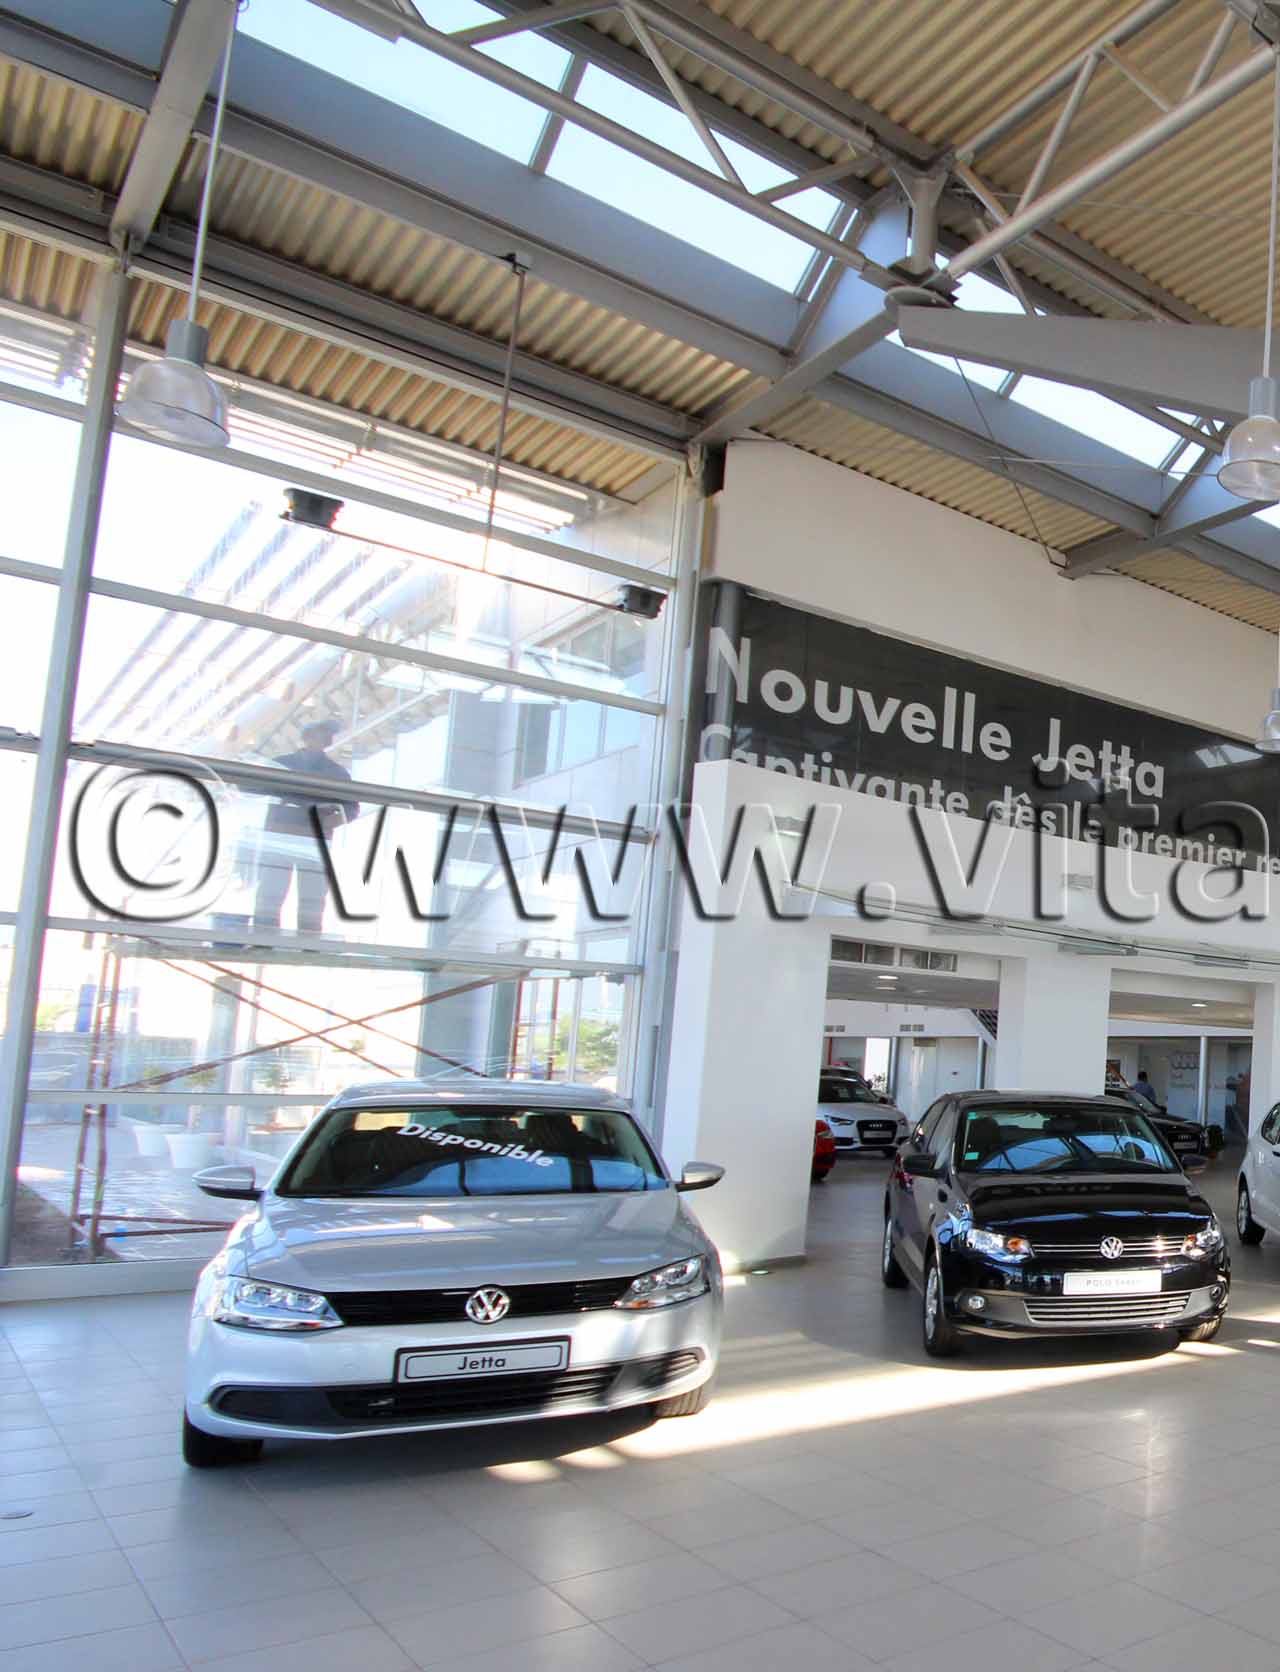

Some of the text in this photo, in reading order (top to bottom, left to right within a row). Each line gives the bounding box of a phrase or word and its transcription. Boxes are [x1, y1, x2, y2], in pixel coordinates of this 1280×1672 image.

[705, 627, 1164, 799] Nouvelle Jetta
[1072, 801, 1102, 843] le
[1118, 826, 1247, 868] premier
[396, 1122, 555, 1167] Disponible
[457, 1356, 507, 1371] Jetta
